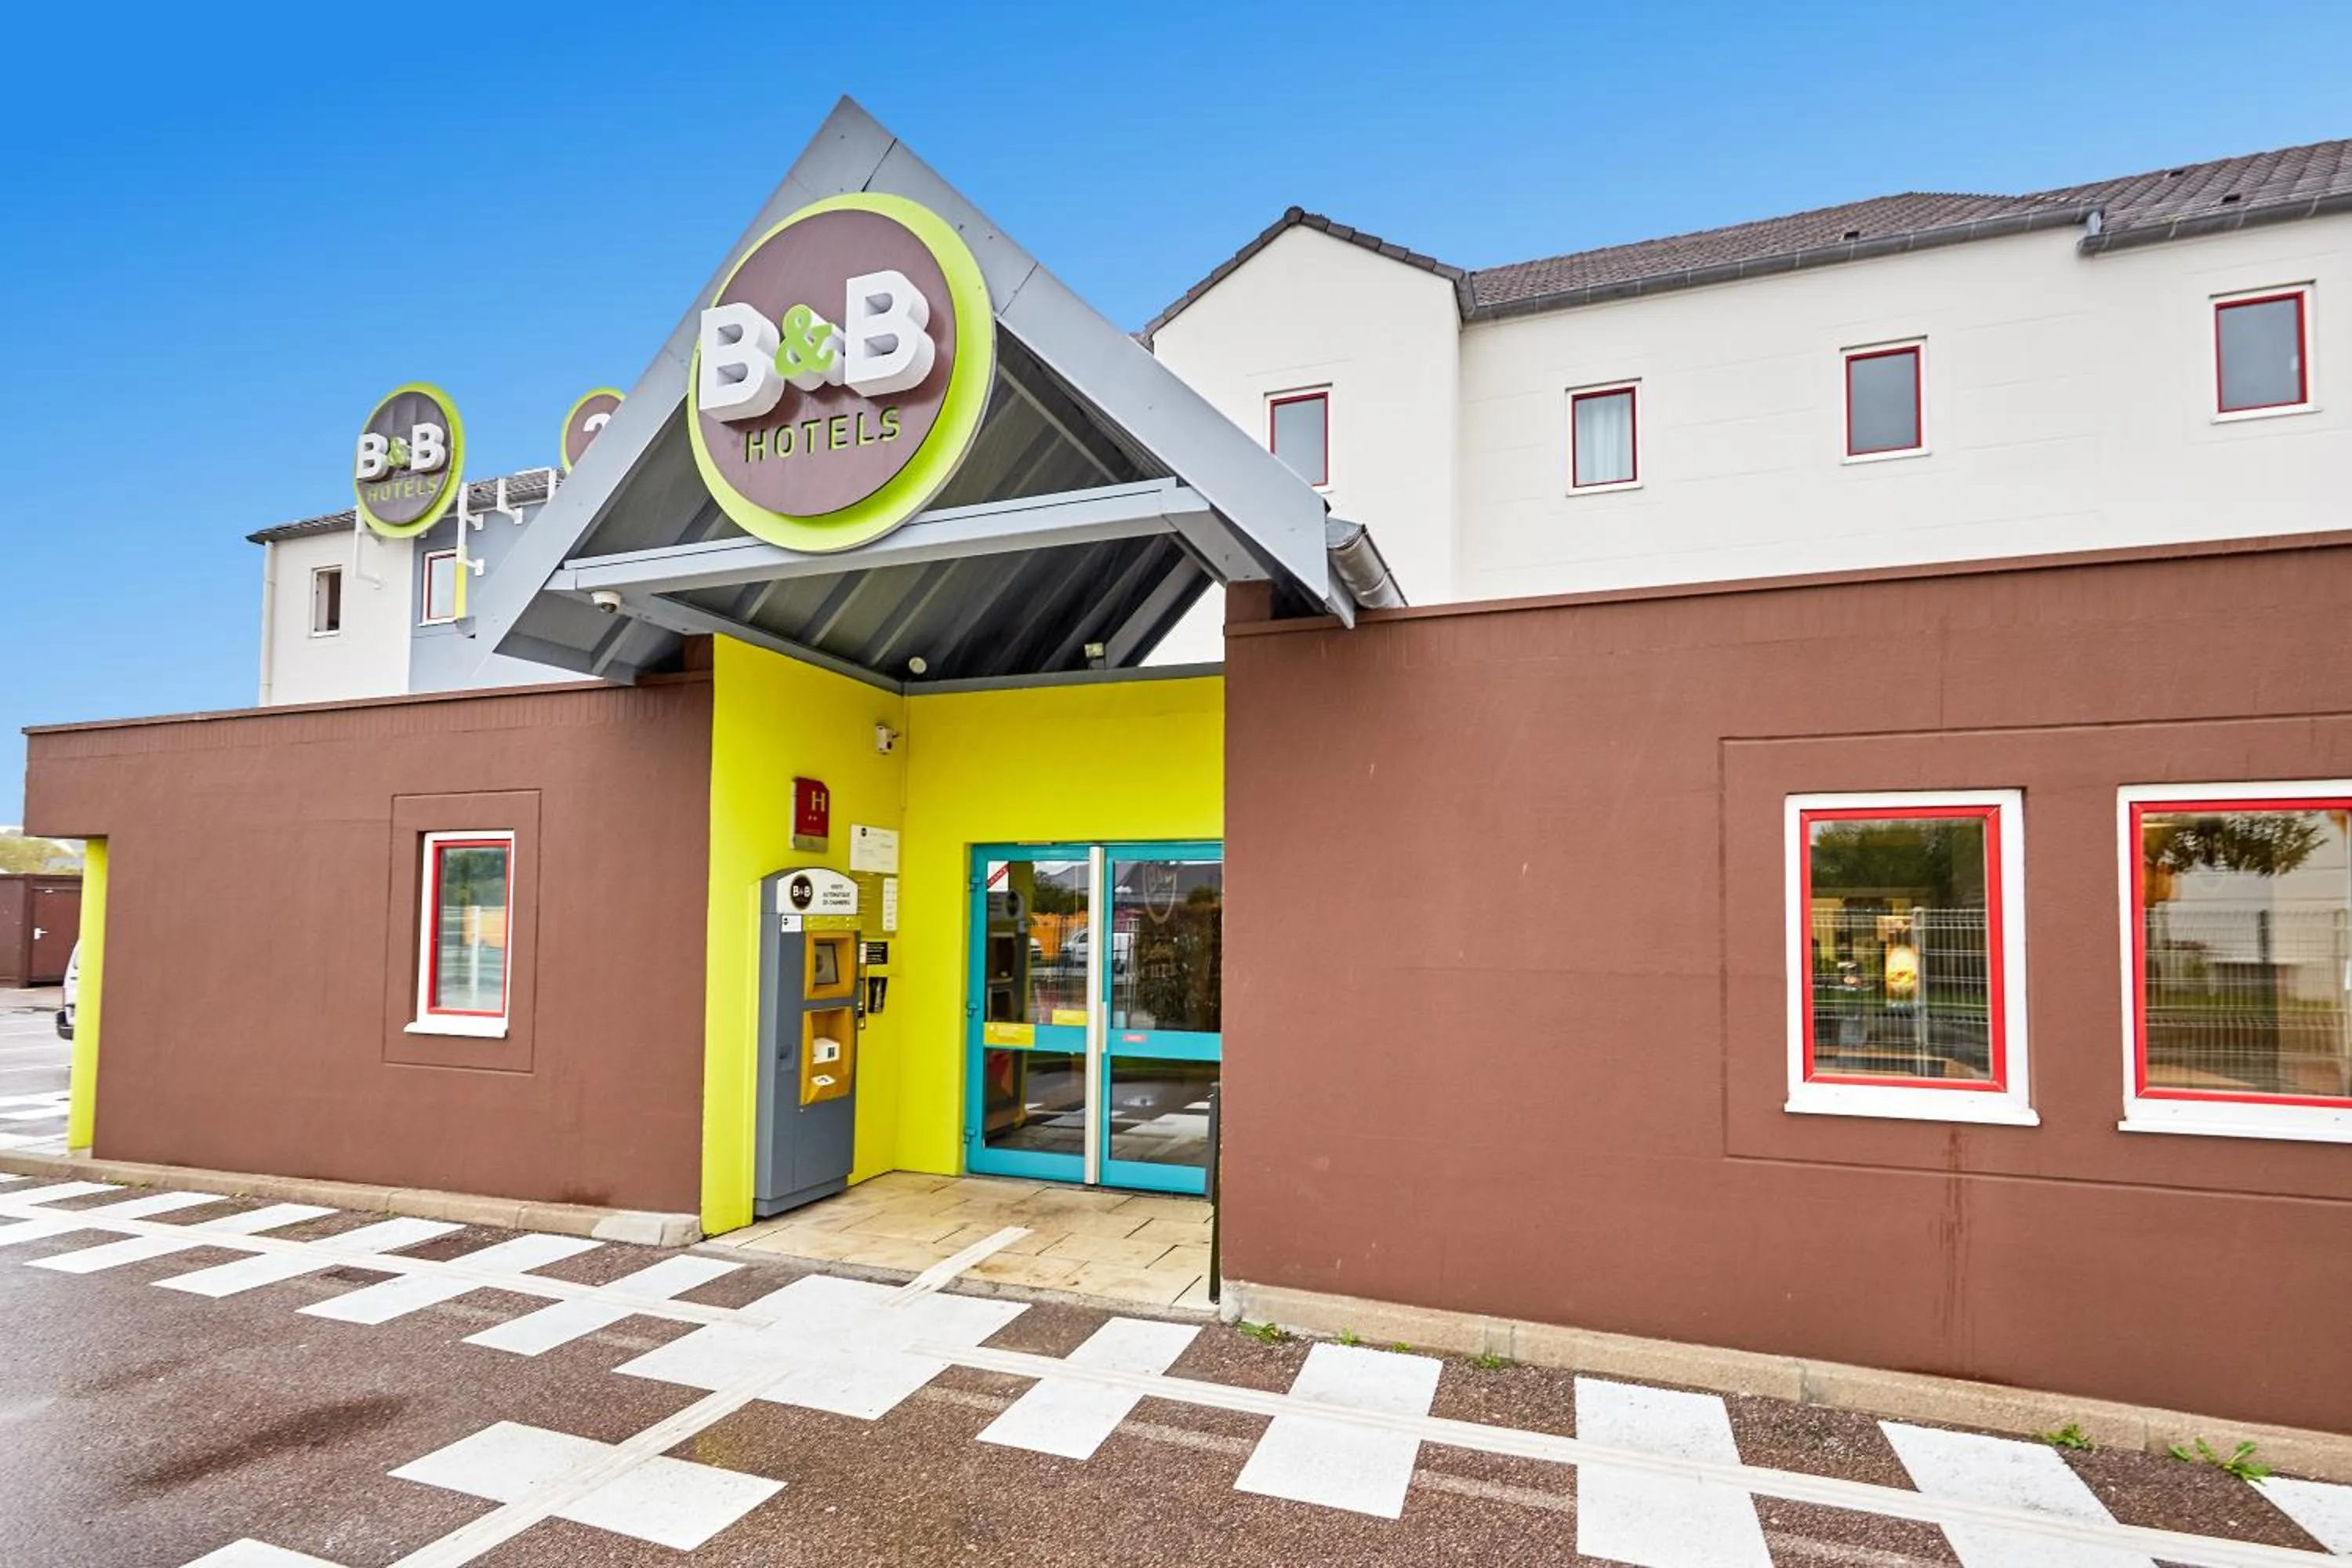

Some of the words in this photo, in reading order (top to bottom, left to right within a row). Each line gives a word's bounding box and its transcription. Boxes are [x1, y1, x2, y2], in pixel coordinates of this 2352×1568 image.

[699, 270, 935, 423] B&B
[356, 423, 445, 480] B&B
[745, 407, 902, 463] HOTELS
[367, 475, 437, 503] HOTELS
[811, 790, 826, 811] H
